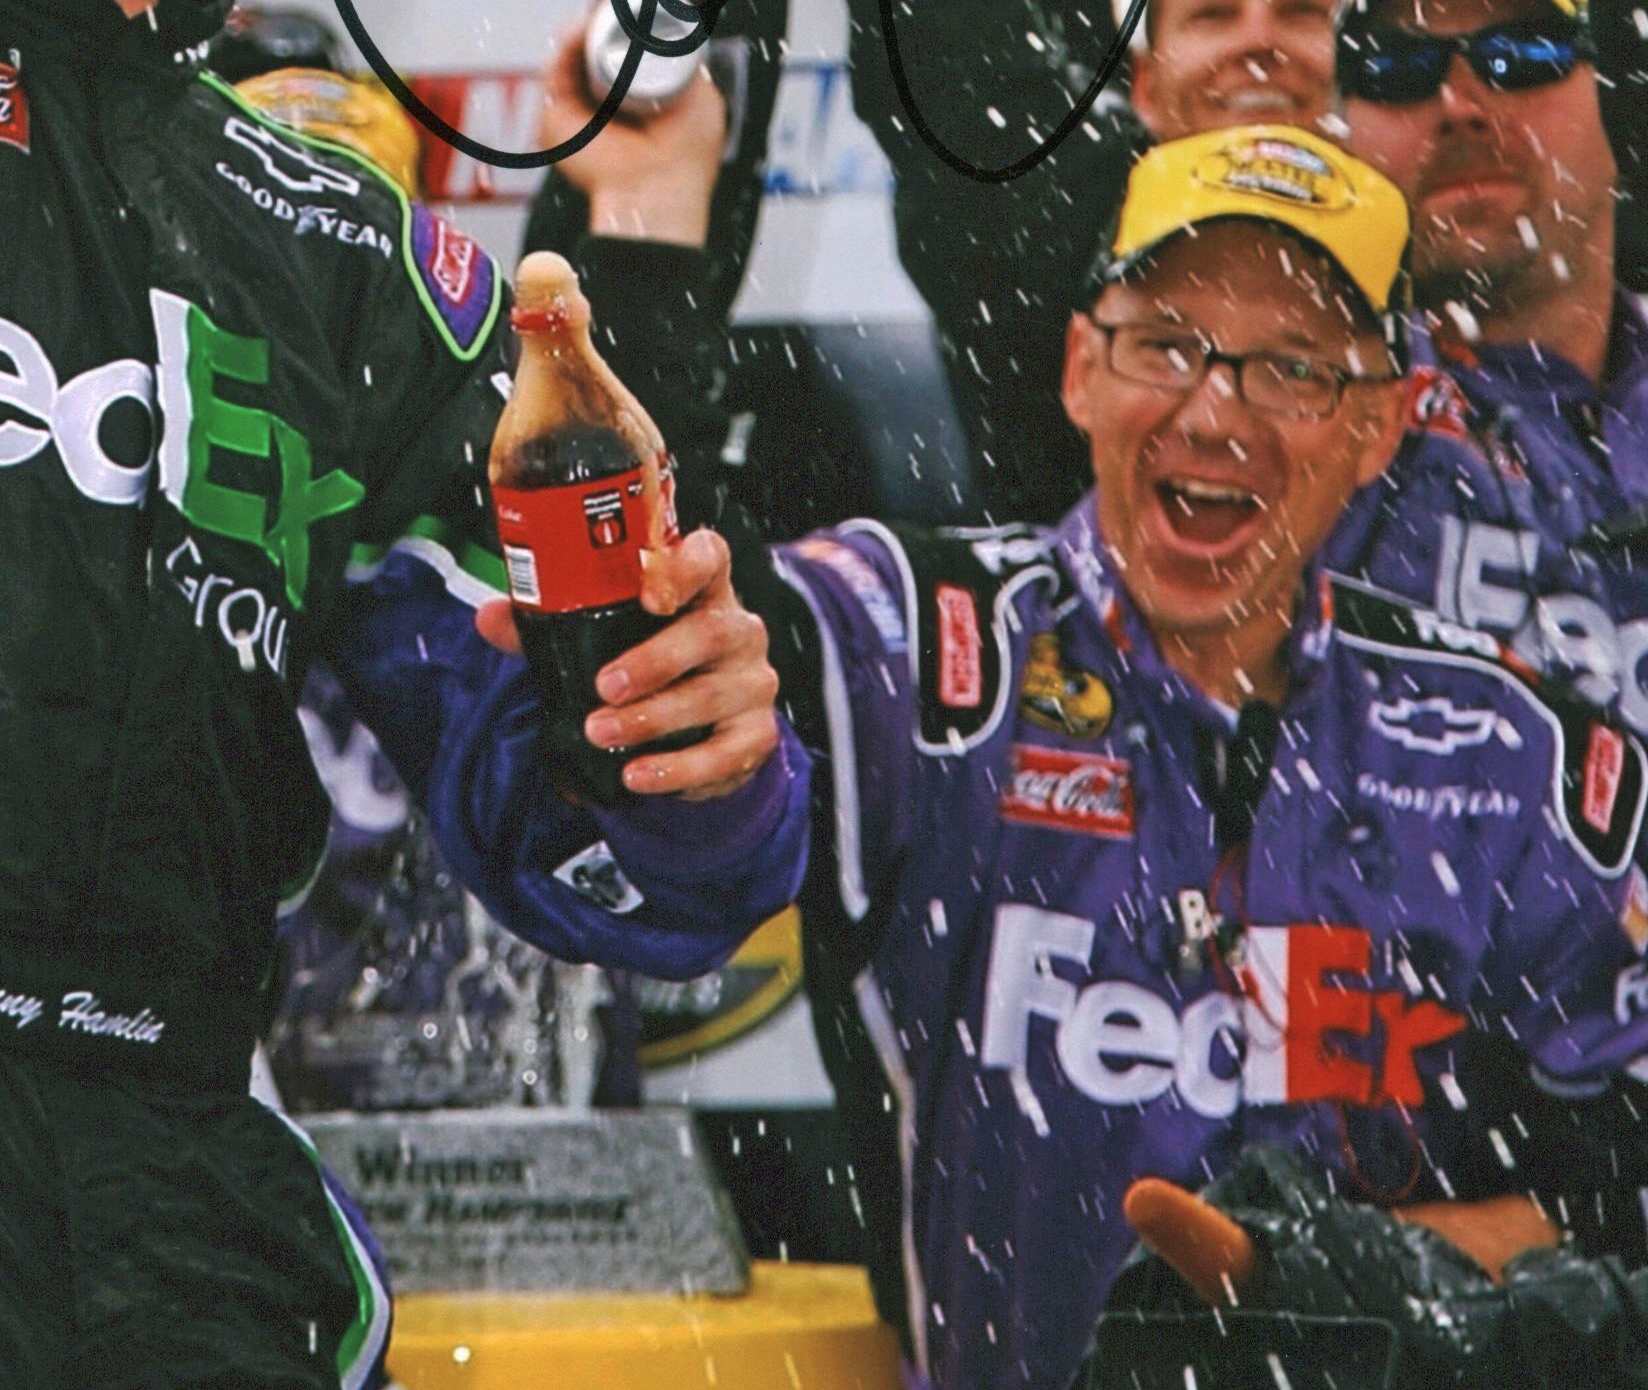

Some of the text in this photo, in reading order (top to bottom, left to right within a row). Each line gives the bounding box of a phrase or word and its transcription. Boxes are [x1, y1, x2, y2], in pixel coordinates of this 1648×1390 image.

[216, 163, 393, 258] GOODYEAR
[58, 991, 165, 1042] Hamlin
[982, 902, 1467, 1118] FedEx
